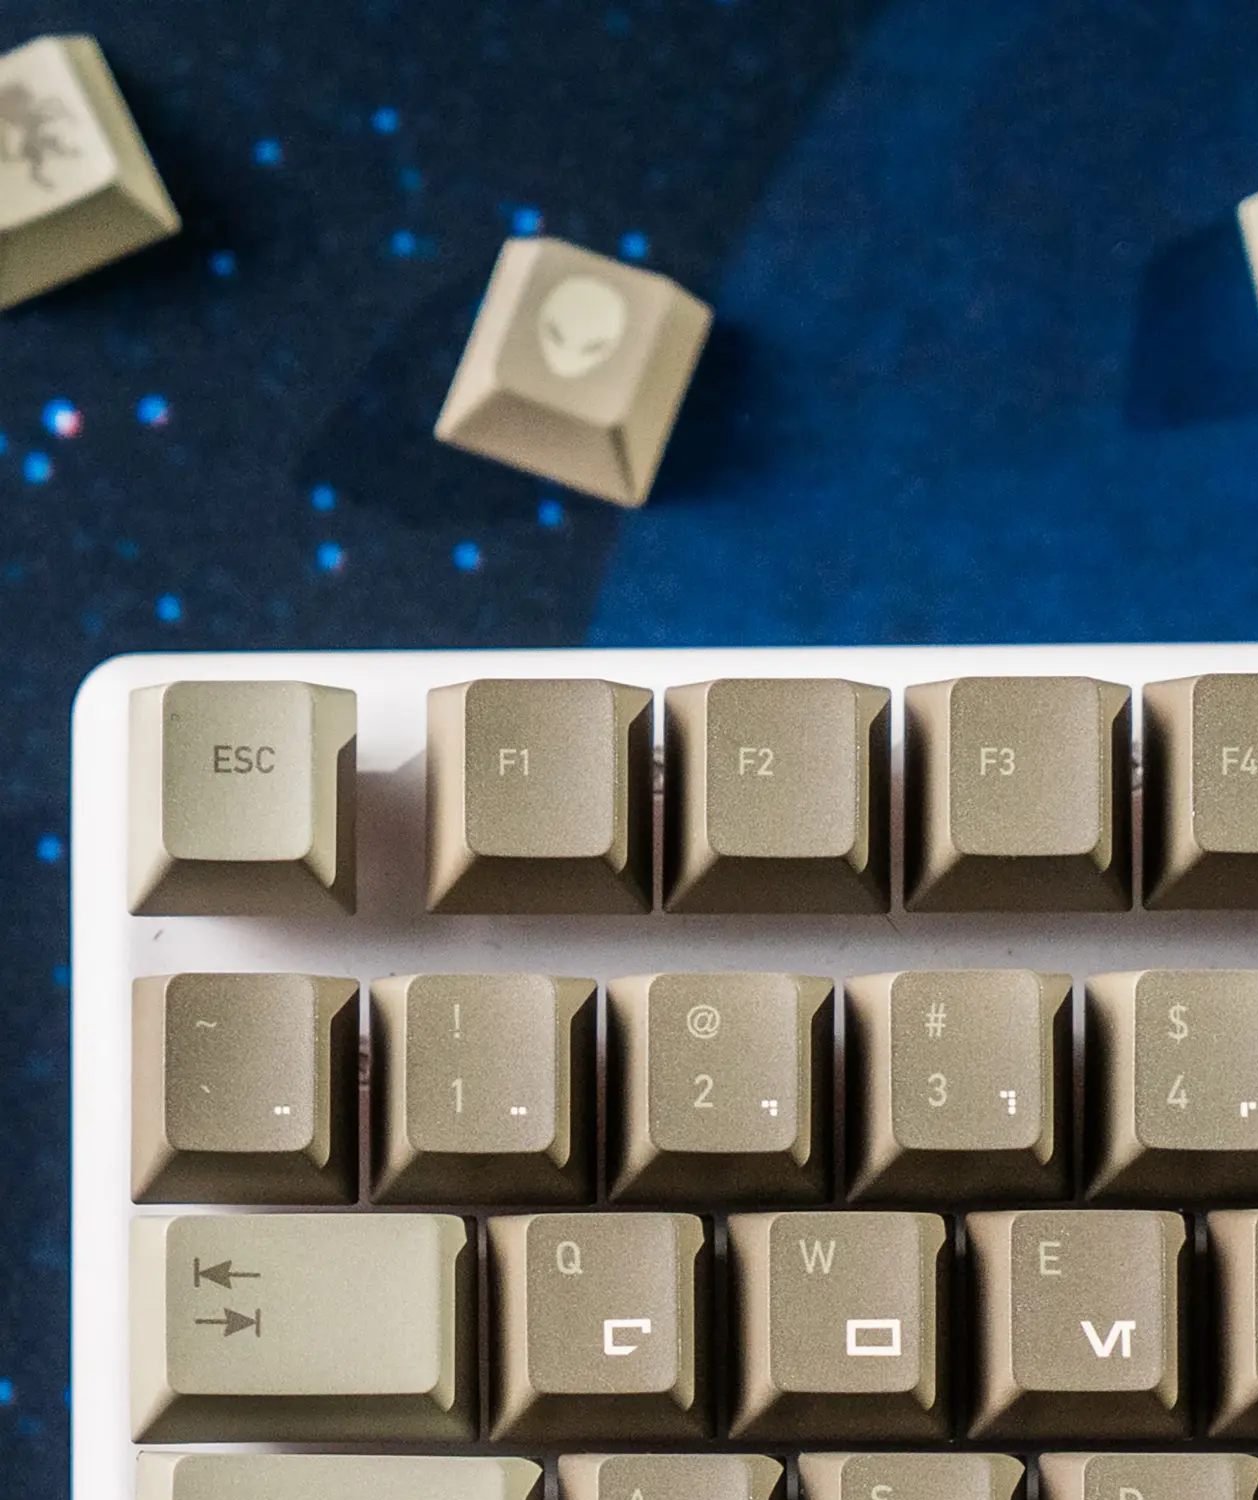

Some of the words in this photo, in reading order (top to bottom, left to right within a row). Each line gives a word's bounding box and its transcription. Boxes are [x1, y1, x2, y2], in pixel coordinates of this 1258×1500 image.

[212, 744, 276, 775] ESC
[499, 748, 530, 776] F1
[738, 747, 774, 777] F2
[980, 747, 1016, 776] F3
[1221, 746, 1258, 776] F4
[686, 1003, 721, 1040] @
[925, 1003, 947, 1038] #
[1168, 1002, 1189, 1042] $
[451, 1078, 463, 1113] 1
[693, 1074, 714, 1109] 2
[928, 1072, 948, 1107] 3
[1166, 1074, 1189, 1109] 4
[556, 1240, 584, 1275] Q
[799, 1239, 836, 1274] W
[1038, 1240, 1062, 1276] E
